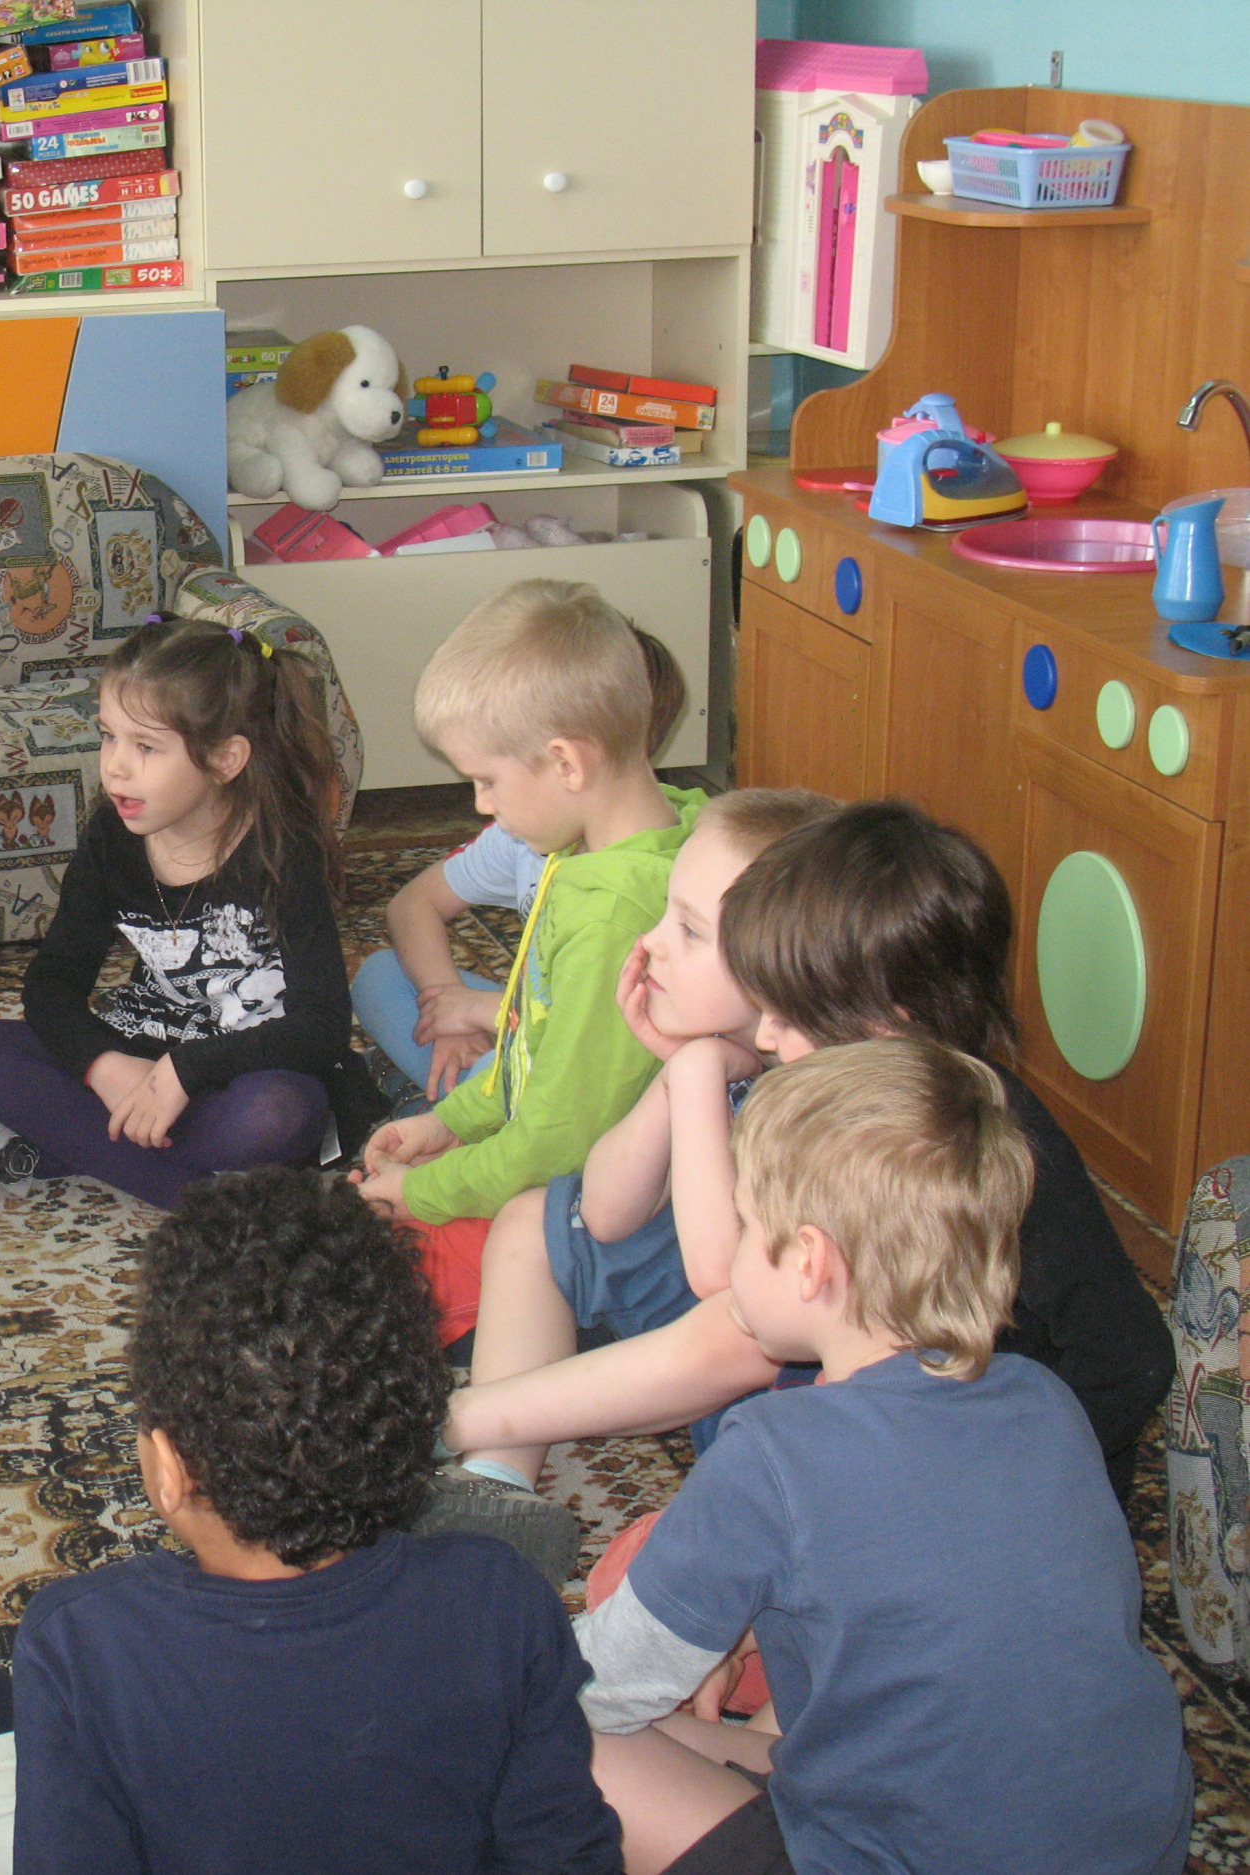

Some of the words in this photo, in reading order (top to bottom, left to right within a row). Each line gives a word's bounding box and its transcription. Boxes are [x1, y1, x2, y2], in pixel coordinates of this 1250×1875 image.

[37, 136, 60, 150] 24
[11, 192, 34, 211] 50
[38, 184, 99, 208] GAMES
[261, 351, 276, 362] 60
[600, 394, 617, 406] 24
[384, 452, 470, 464] электровикторина
[386, 467, 403, 477] для
[404, 465, 433, 476] детей
[434, 464, 450, 474] 4-8
[452, 464, 468, 473] лет
